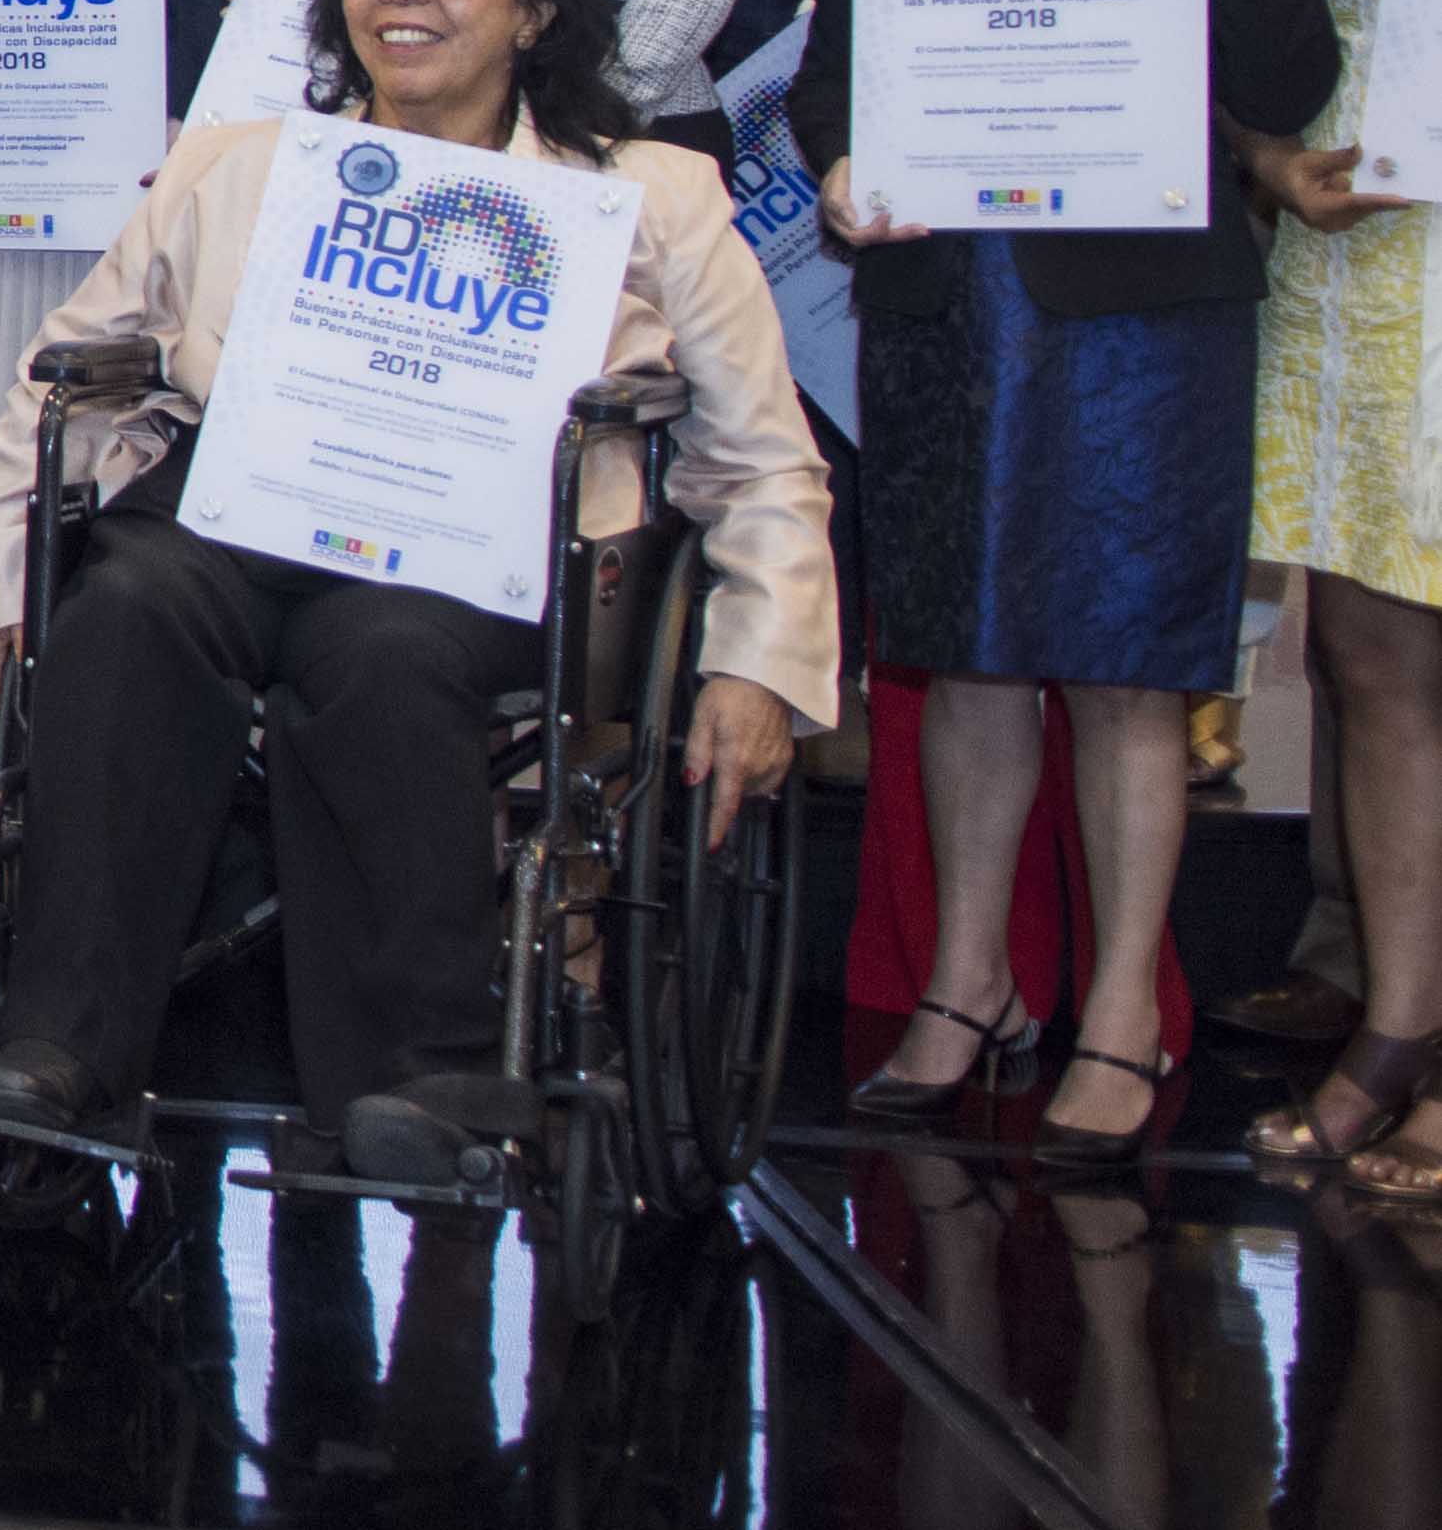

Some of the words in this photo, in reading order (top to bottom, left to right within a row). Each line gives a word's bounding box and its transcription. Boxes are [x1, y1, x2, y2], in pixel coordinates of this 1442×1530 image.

[26, 23, 85, 33] Inclusivas
[89, 24, 117, 34] para
[33, 36, 117, 47] Discapacidad
[988, 9, 1056, 30] 2018
[329, 198, 423, 260] RD
[301, 224, 552, 336] Incluye
[289, 311, 311, 327] las
[317, 318, 389, 346] Personas
[395, 341, 423, 354] con
[429, 345, 534, 381] Discapacidad
[292, 297, 348, 321] Buenas
[425, 329, 499, 356] Inclusivas
[501, 350, 537, 366] para
[368, 351, 441, 385] 2018
